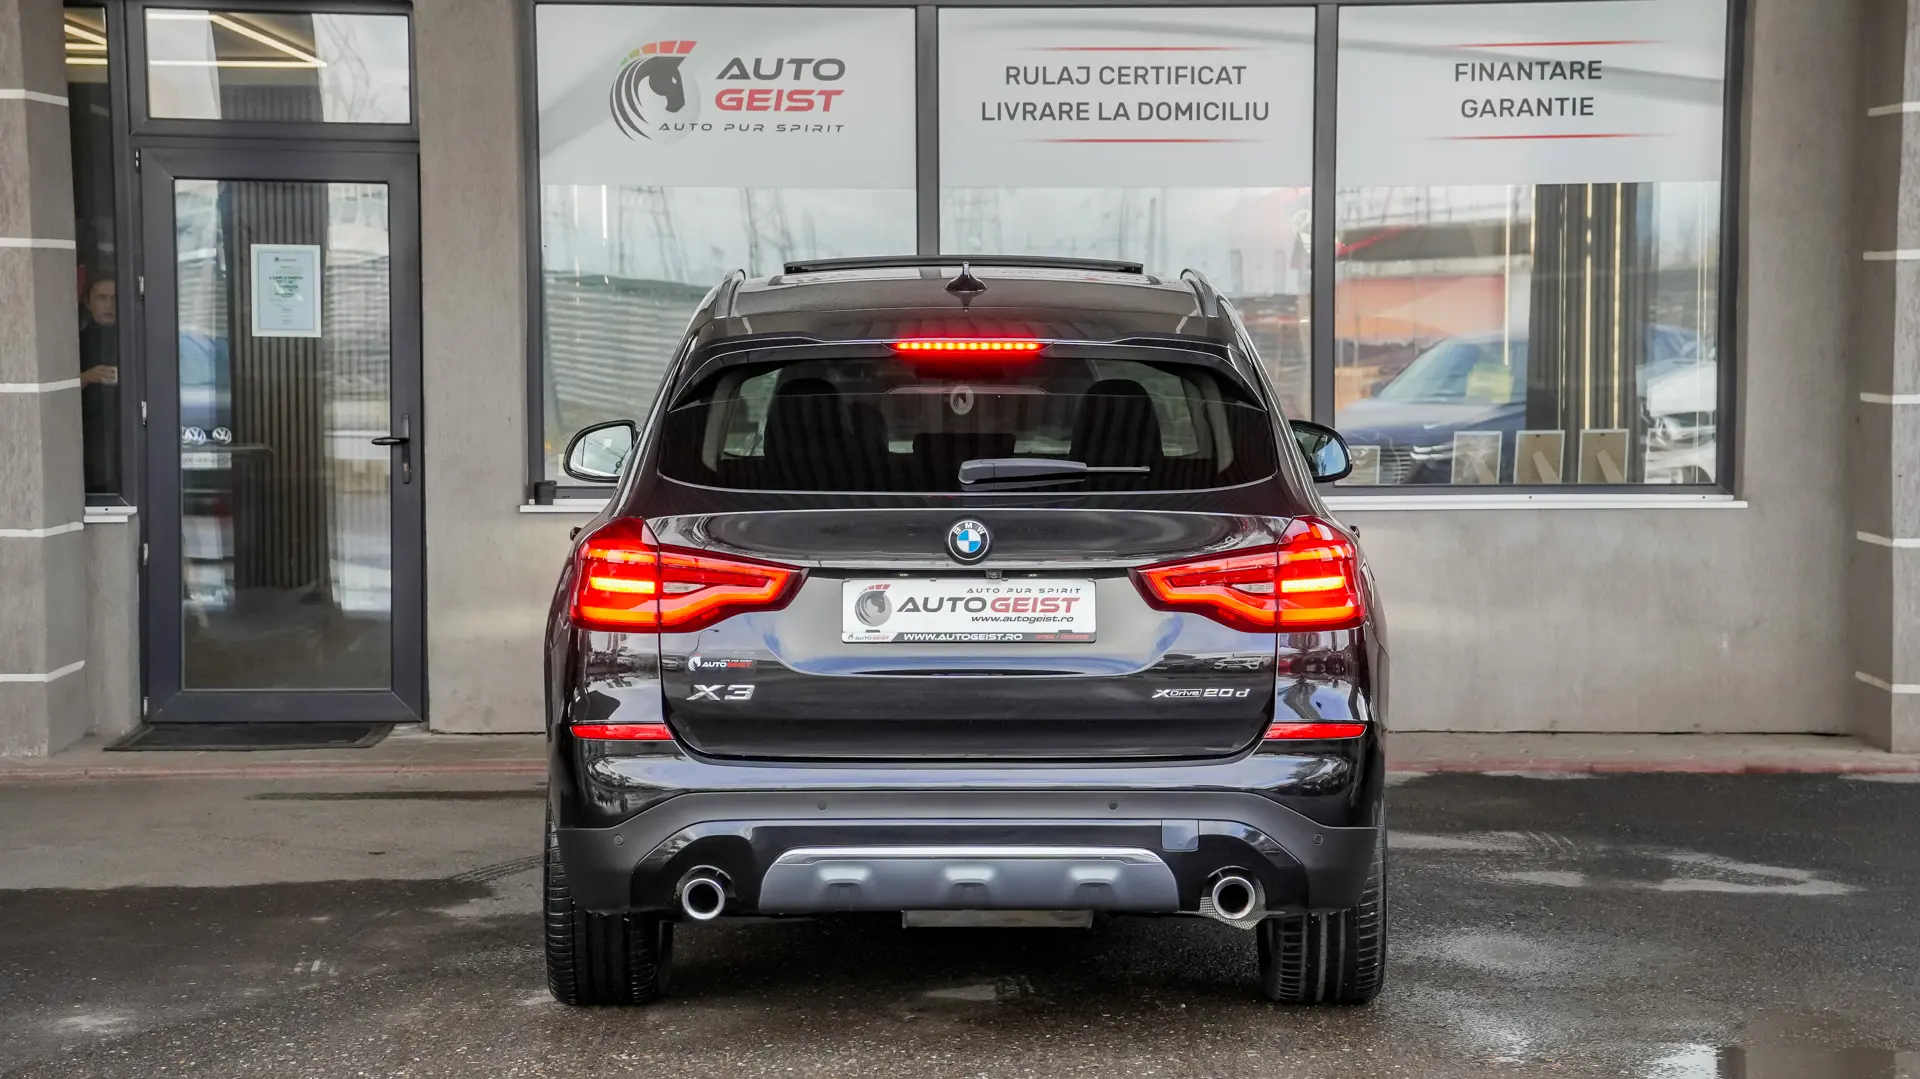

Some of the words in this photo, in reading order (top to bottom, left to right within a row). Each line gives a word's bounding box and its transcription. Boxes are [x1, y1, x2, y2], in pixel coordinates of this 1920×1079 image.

[715, 57, 846, 81] AUTO
[1005, 65, 1092, 86] RULAJ
[1098, 65, 1247, 86] CERTIFICAT
[1454, 60, 1603, 82] FINANTARE
[714, 88, 845, 112] GEIST
[1461, 97, 1595, 118] GARANTIE
[981, 101, 1090, 122] LIVRARE
[1098, 101, 1131, 122] LA
[1137, 101, 1270, 122] DOMICILIU
[658, 122, 713, 131] AUTO
[724, 123, 765, 132] PUR
[775, 123, 845, 133] SPIRIT
[953, 522, 986, 535] BMW
[896, 596, 1081, 614] AUTOGEIST
[971, 615, 1074, 624] www.autogeist.ro
[903, 633, 1023, 641] WWW.AUTOGEIST.RO
[686, 684, 755, 700] X3
